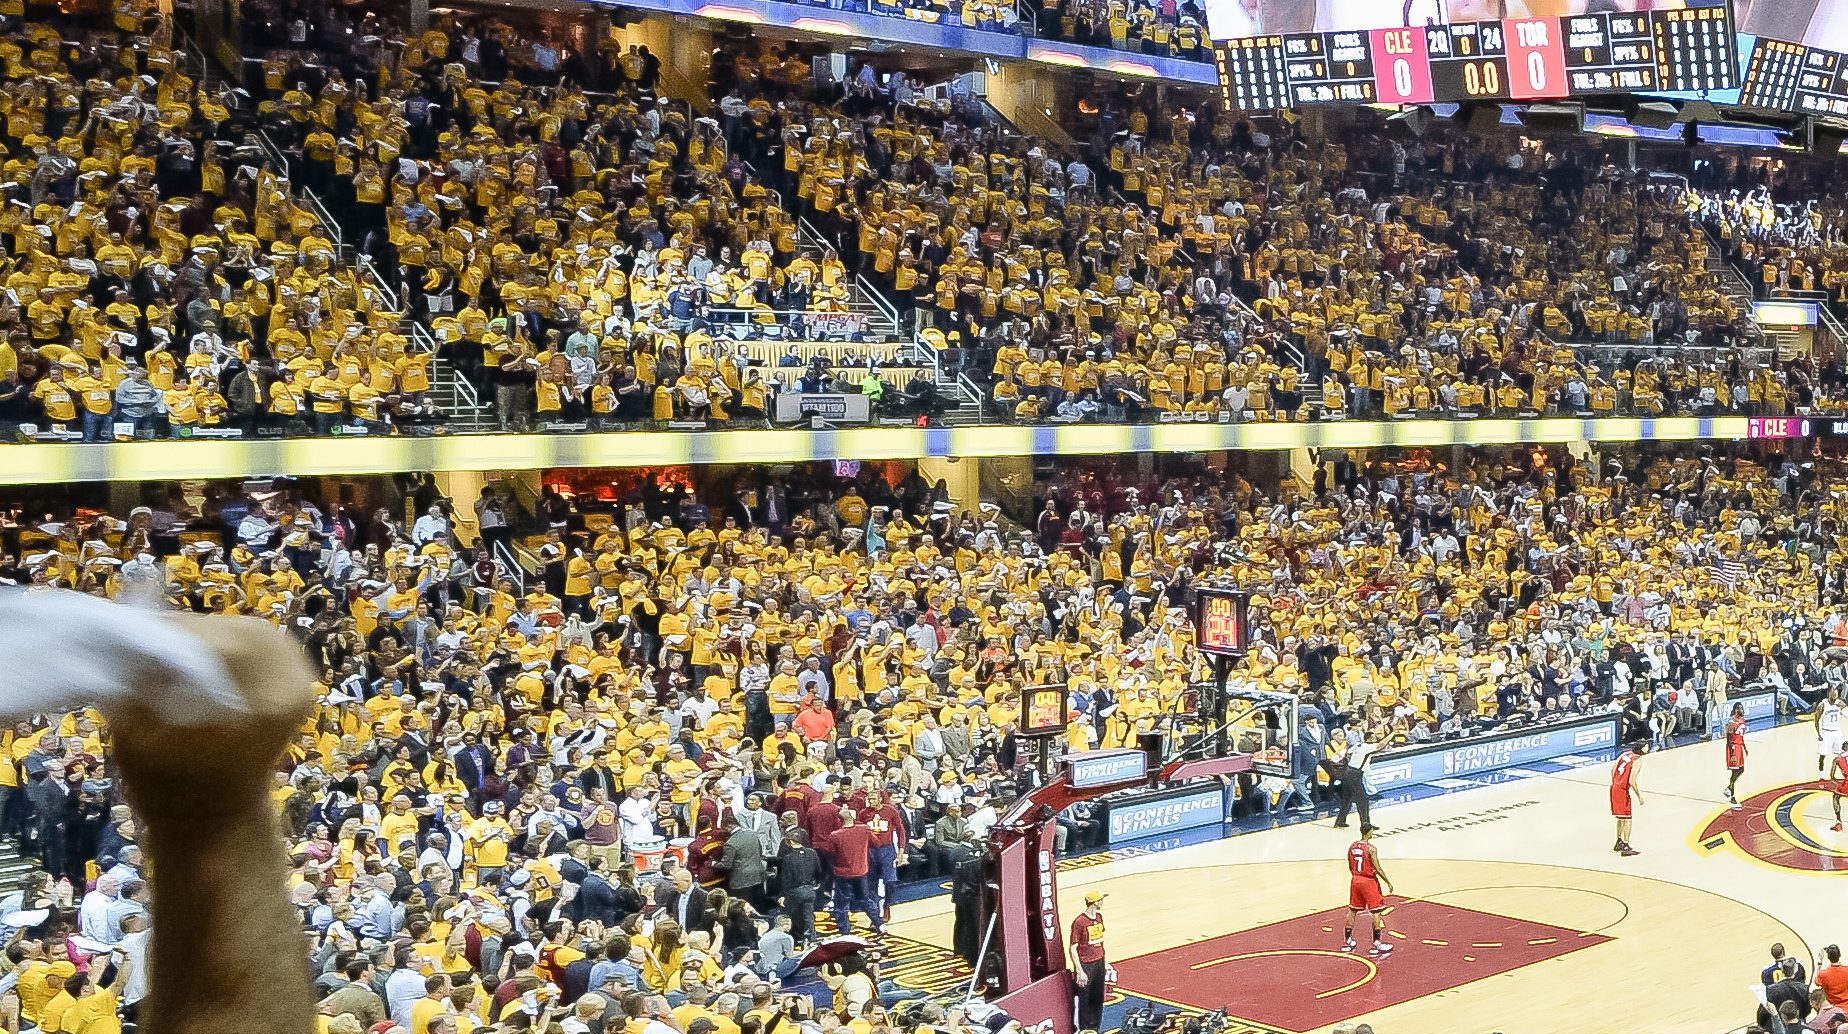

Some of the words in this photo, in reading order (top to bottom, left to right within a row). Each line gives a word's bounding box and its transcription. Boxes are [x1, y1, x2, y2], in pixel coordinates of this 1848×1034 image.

[1384, 30, 1413, 55] CLE
[1483, 27, 1501, 50] 24
[1515, 21, 1549, 48] TOR
[1393, 58, 1412, 97] 0
[1464, 62, 1499, 95] 0.0
[1527, 51, 1546, 91] 0
[1764, 419, 1788, 436] CLE
[1801, 419, 1809, 436] 0
[1455, 735, 1548, 759] CONFERENCE
[1454, 752, 1511, 773] FINALS
[1123, 796, 1219, 824] CONFERENCE
[1122, 813, 1181, 834] FINALS
[1353, 856, 1363, 872] 7
